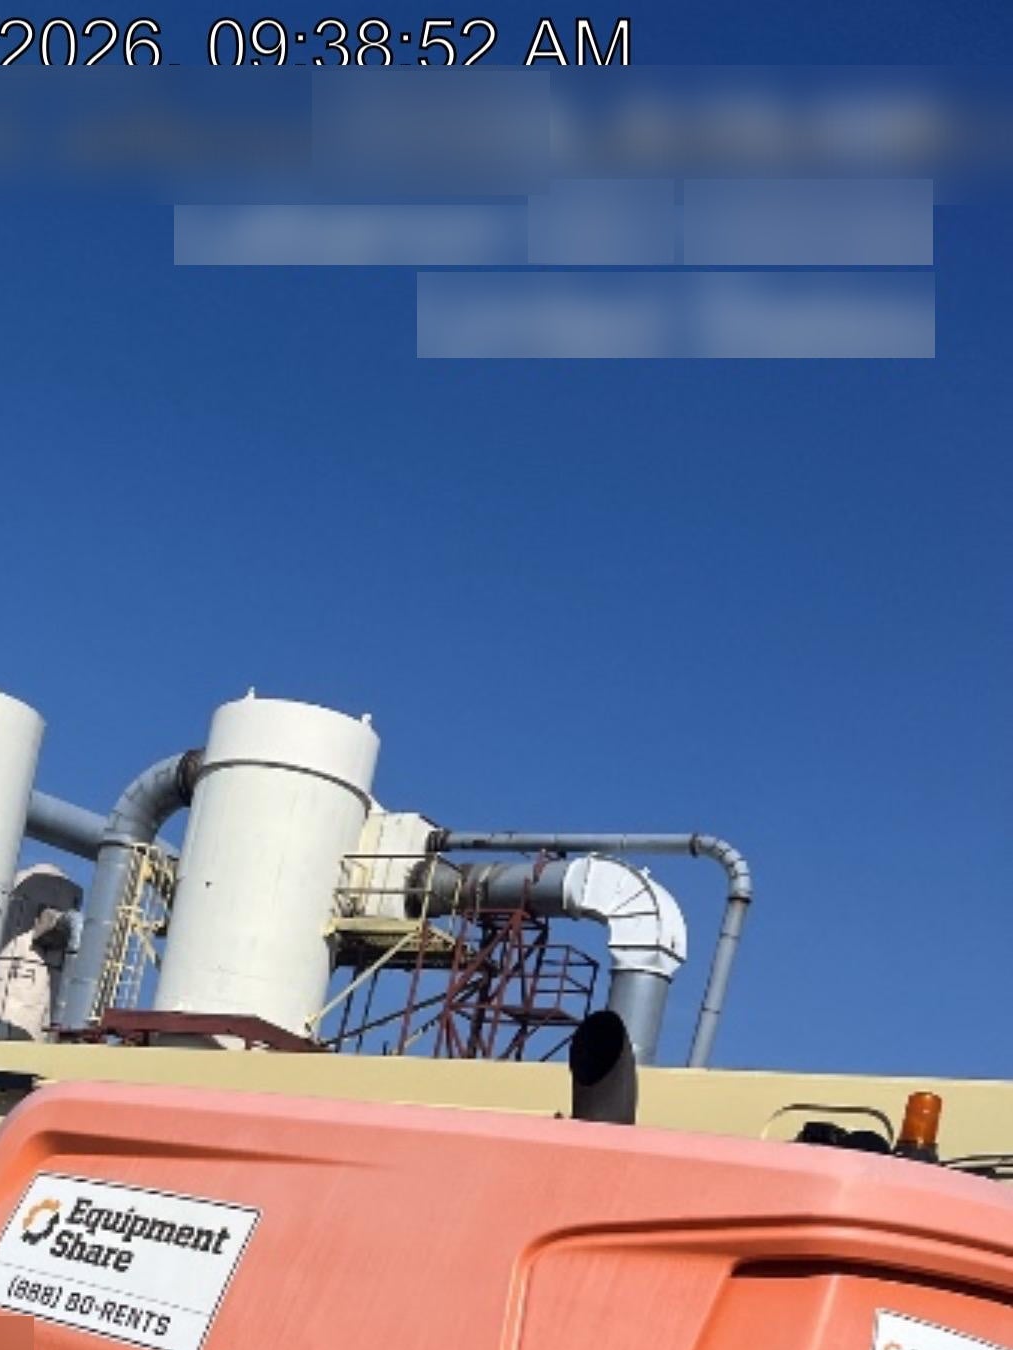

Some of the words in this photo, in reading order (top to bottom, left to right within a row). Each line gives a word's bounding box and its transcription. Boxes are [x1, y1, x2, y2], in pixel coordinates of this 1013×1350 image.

[50, 1230, 134, 1273] Share
[65, 1198, 230, 1254] Equipment
[7, 1275, 63, 1308] (888)
[64, 1292, 171, 1336] 80-RENTS
